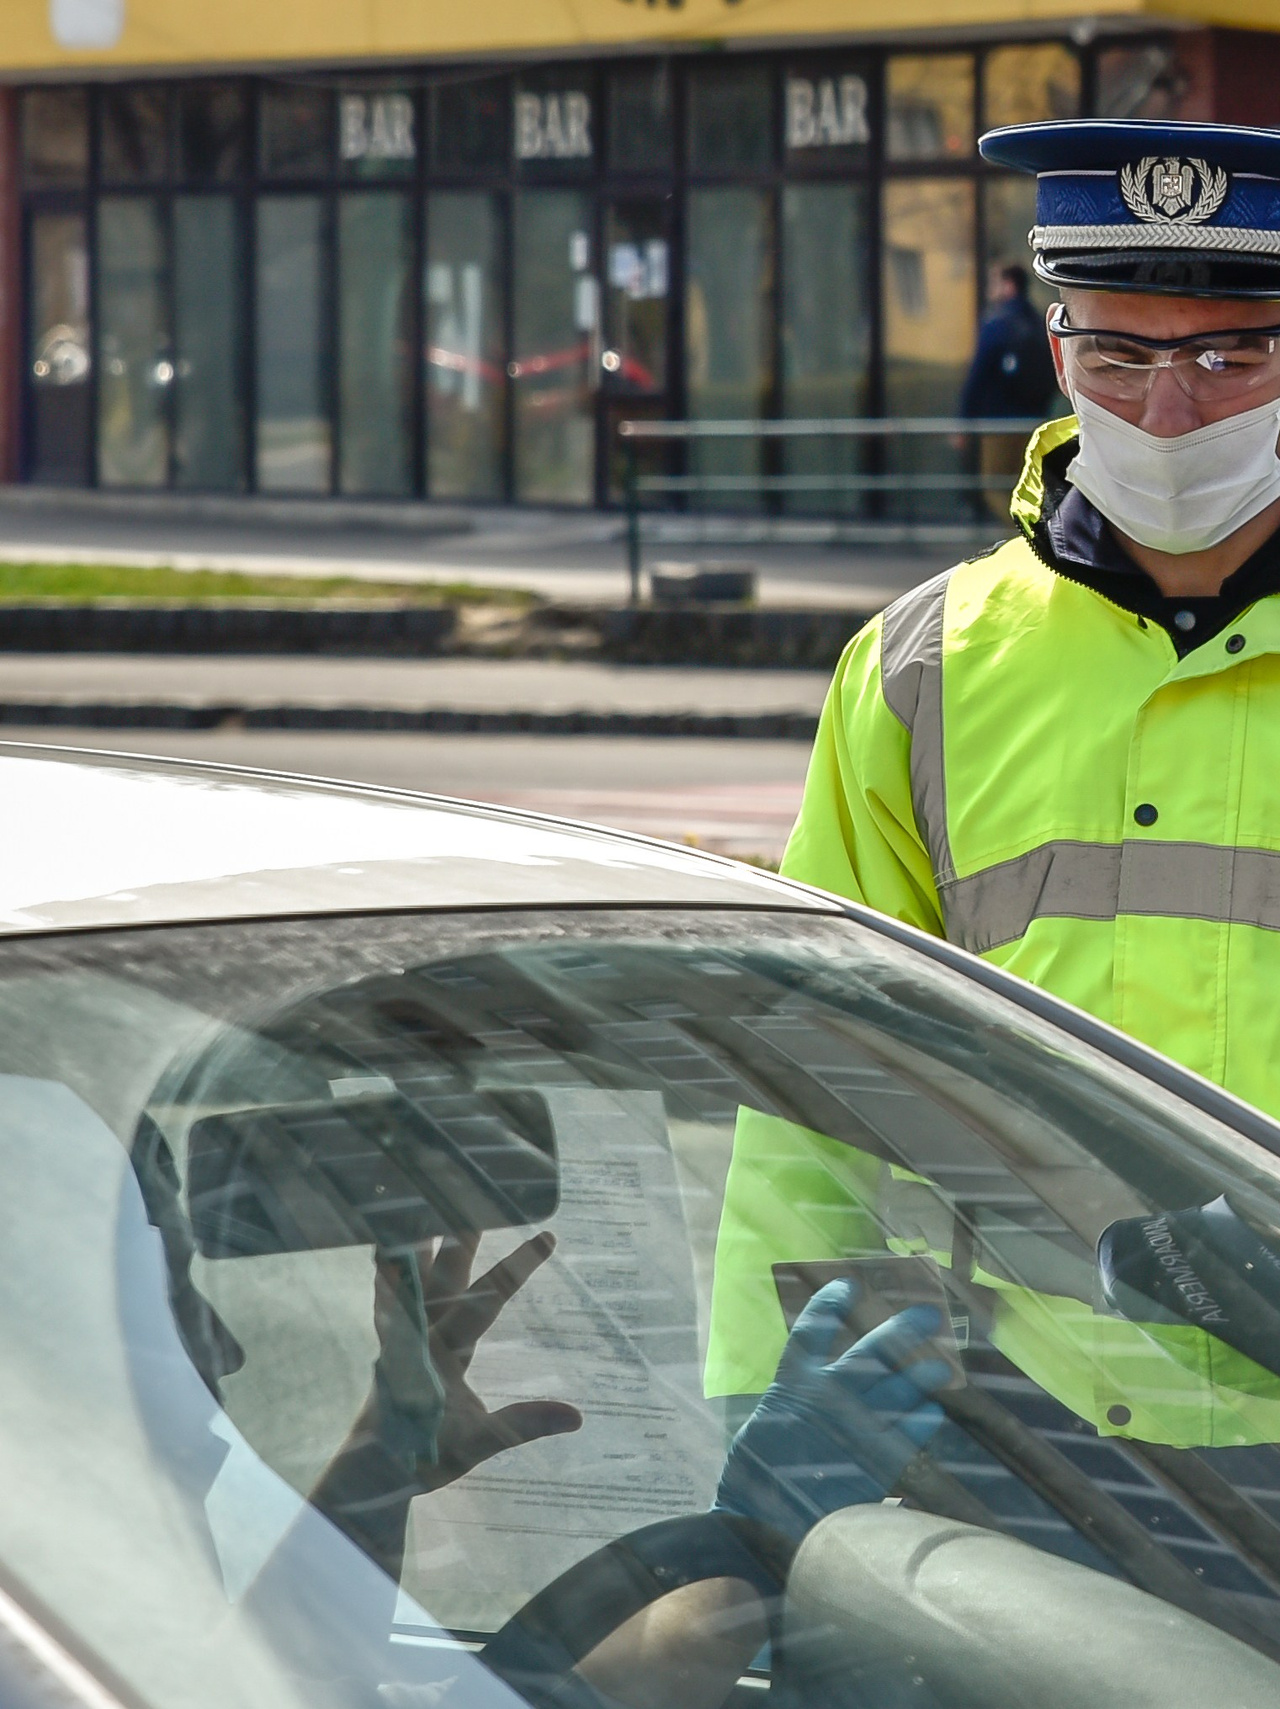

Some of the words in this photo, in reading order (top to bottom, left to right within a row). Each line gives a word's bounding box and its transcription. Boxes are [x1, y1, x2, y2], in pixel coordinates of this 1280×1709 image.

[339, 94, 416, 159] BAR
[514, 91, 592, 159] BAR
[785, 74, 870, 147] BAR
